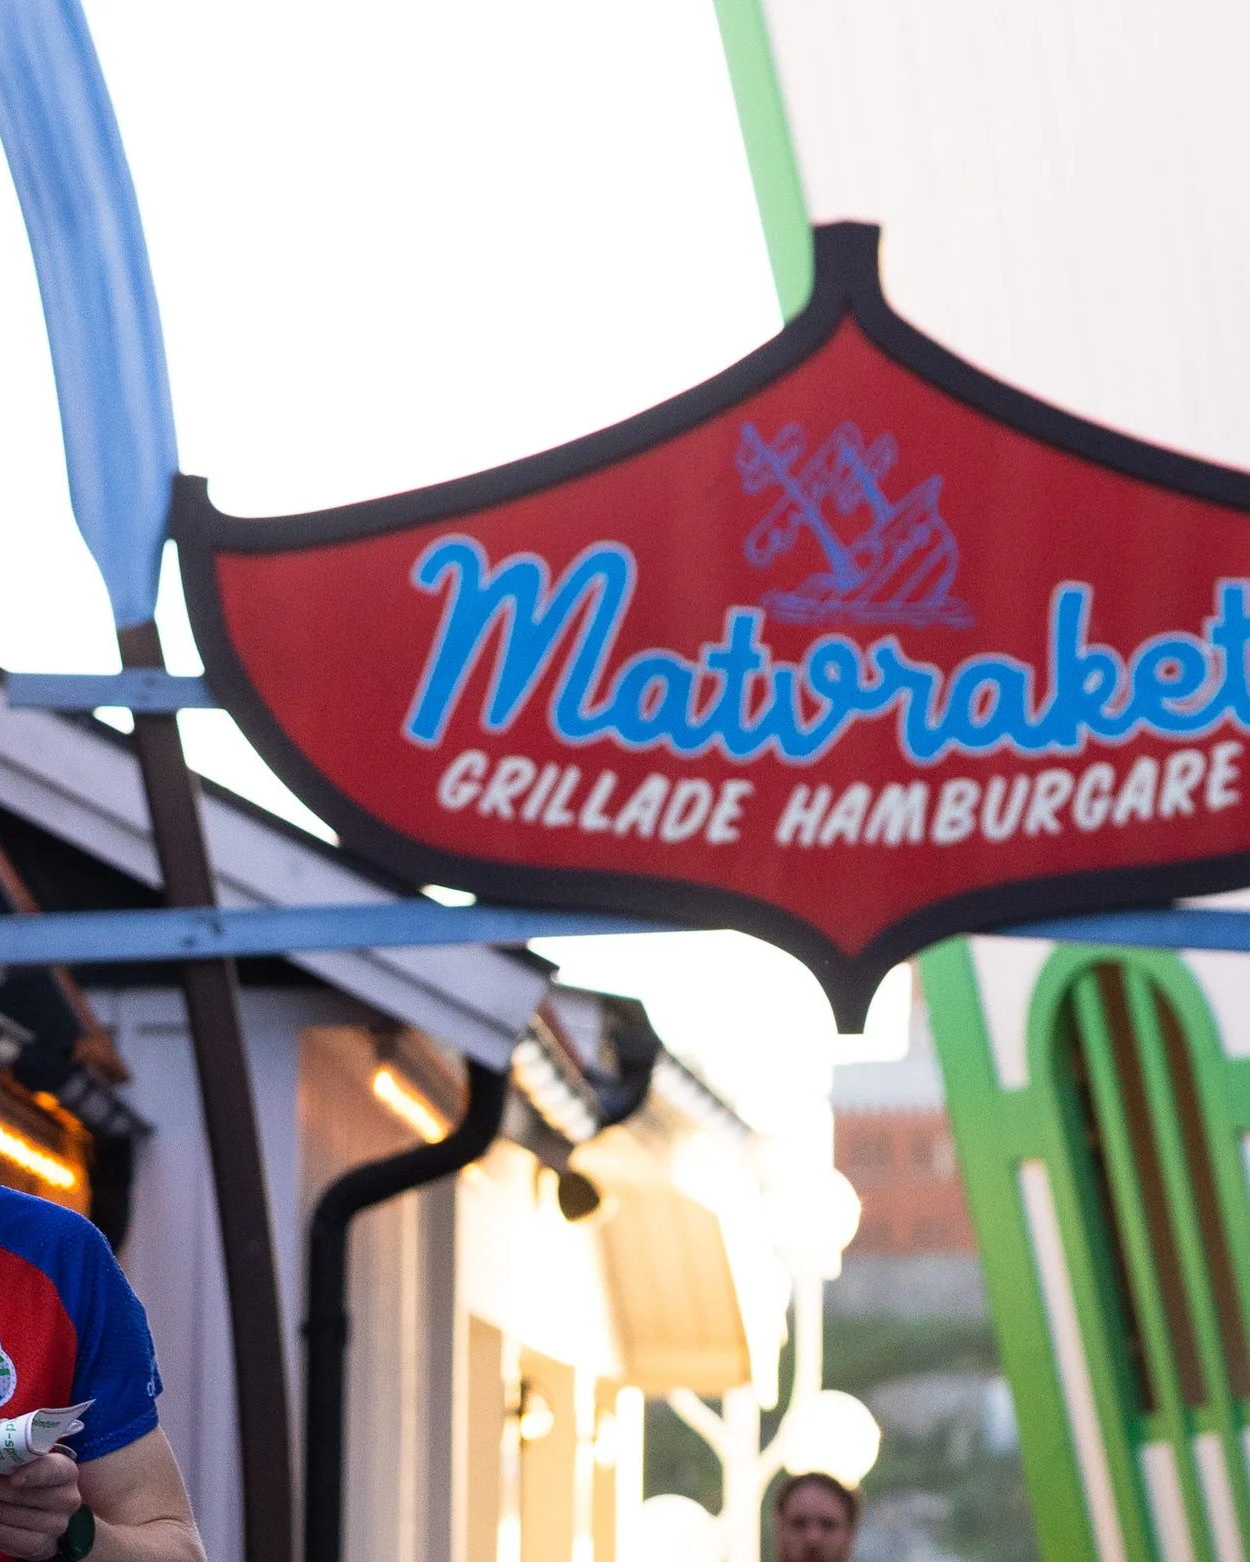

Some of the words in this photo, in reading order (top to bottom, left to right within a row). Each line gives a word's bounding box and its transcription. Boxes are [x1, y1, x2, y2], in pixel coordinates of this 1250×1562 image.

[401, 533, 1250, 767] Matvraket
[438, 748, 755, 844] GRILLADE
[775, 741, 1244, 847] HAMBURGARE
